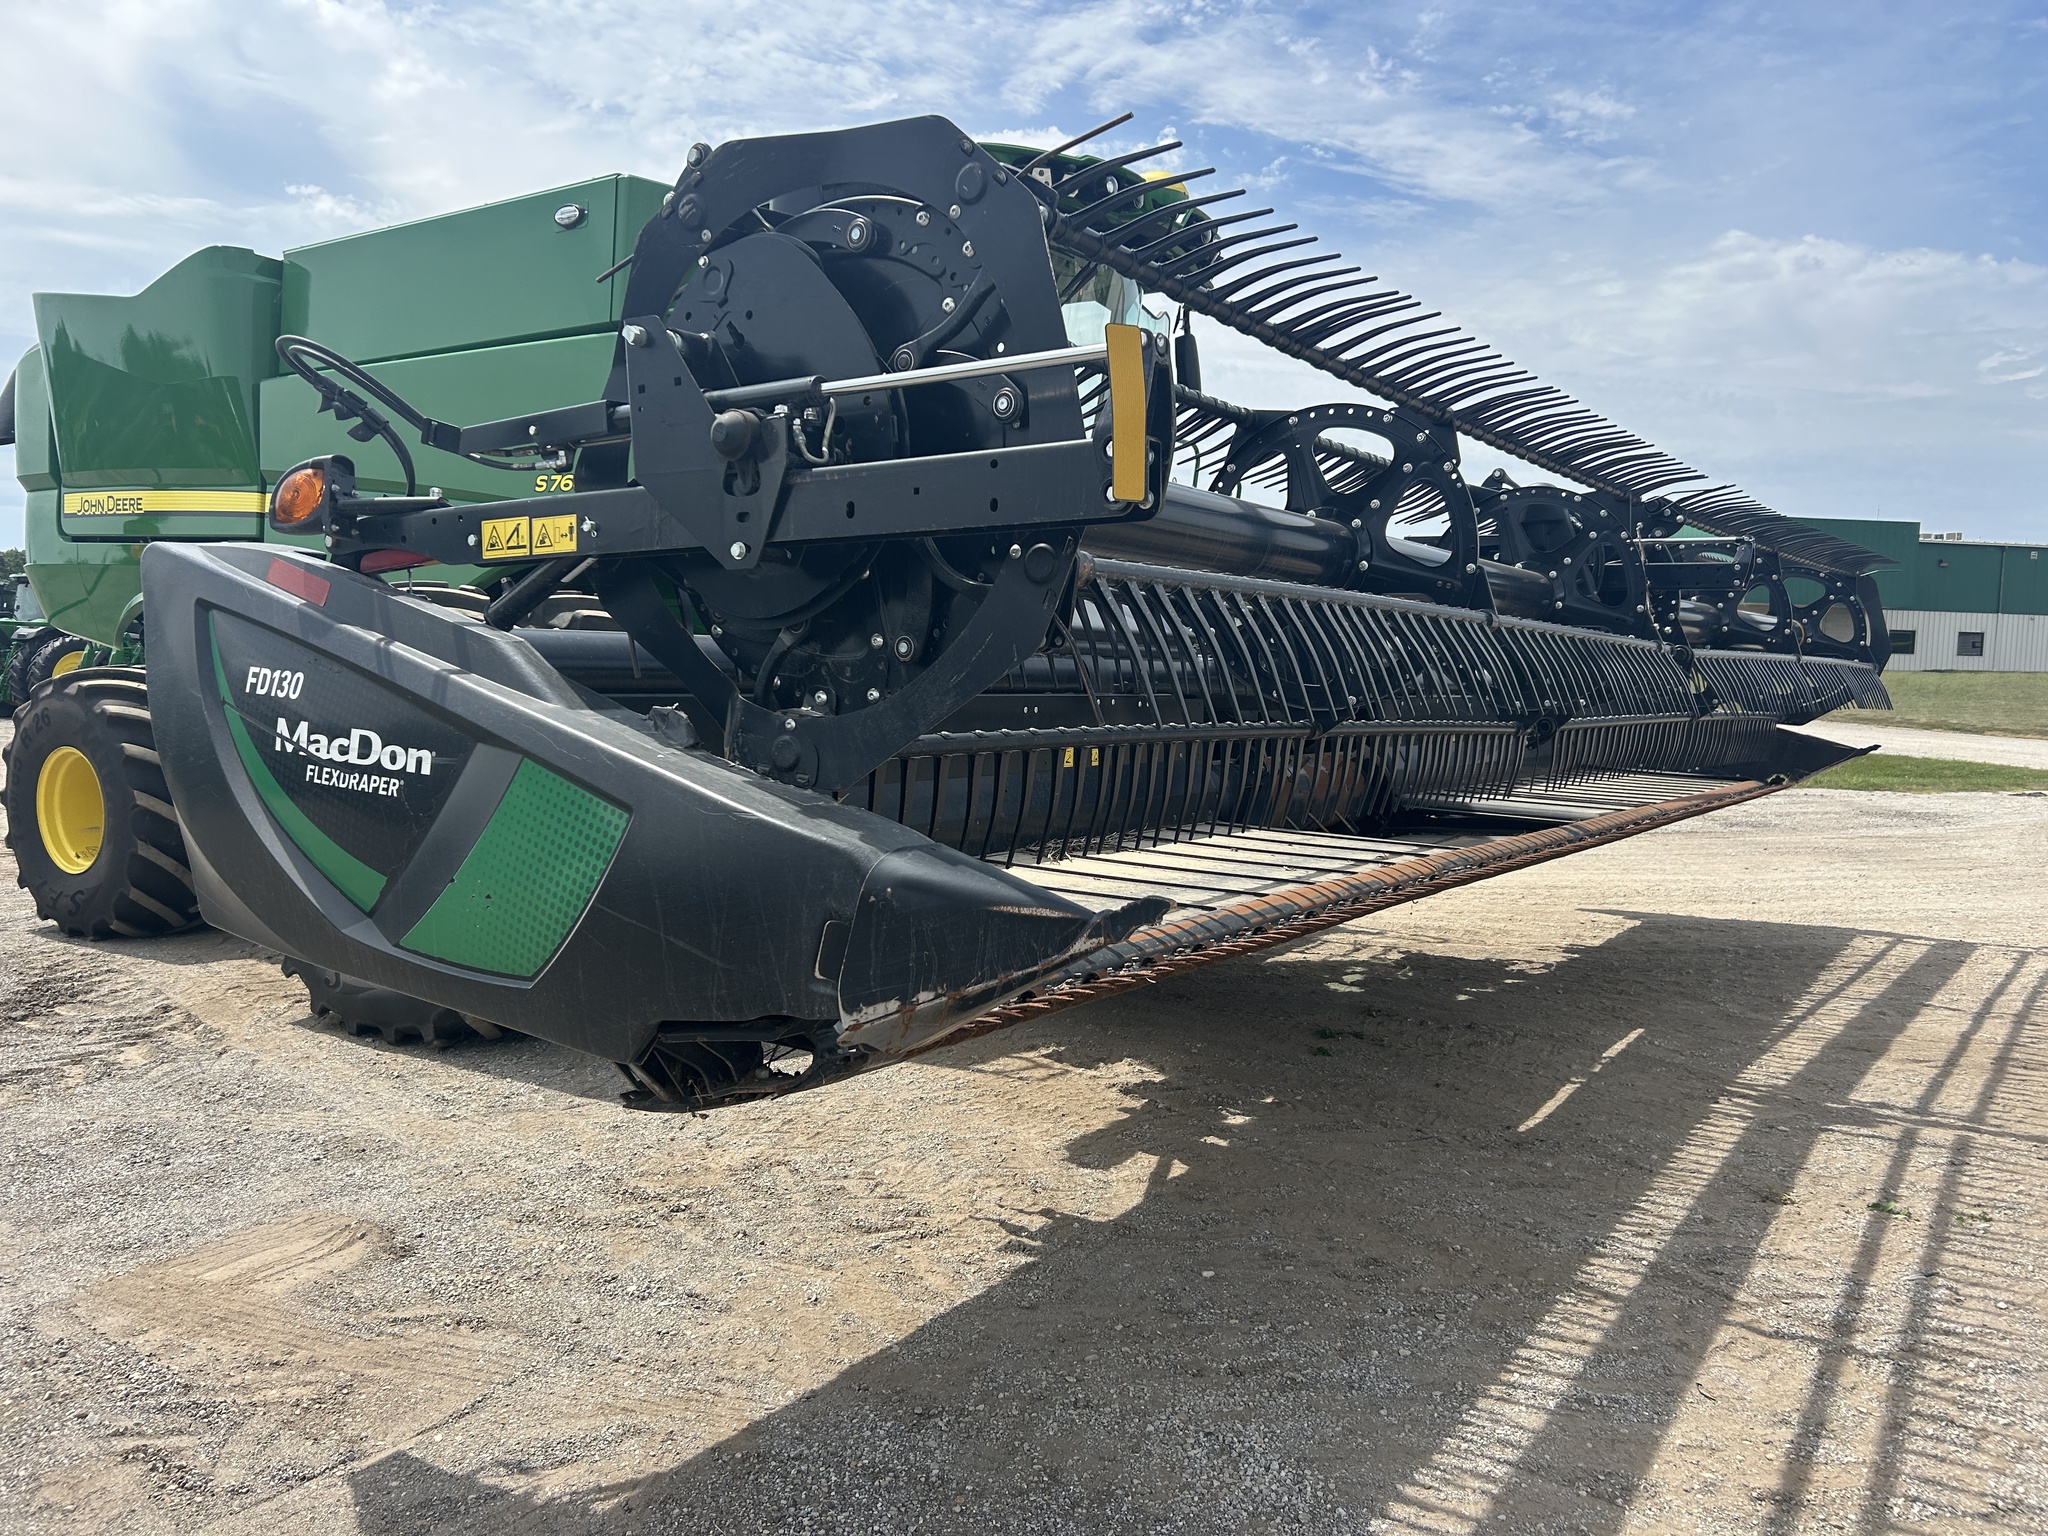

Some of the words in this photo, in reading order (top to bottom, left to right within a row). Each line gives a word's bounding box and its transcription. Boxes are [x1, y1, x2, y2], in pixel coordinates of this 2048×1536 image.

[77, 496, 105, 513] JOHN
[107, 495, 143, 512] DEERE
[245, 666, 305, 700] FD130
[274, 717, 433, 776] MacDon
[305, 764, 400, 797] FLEXDRAPER
